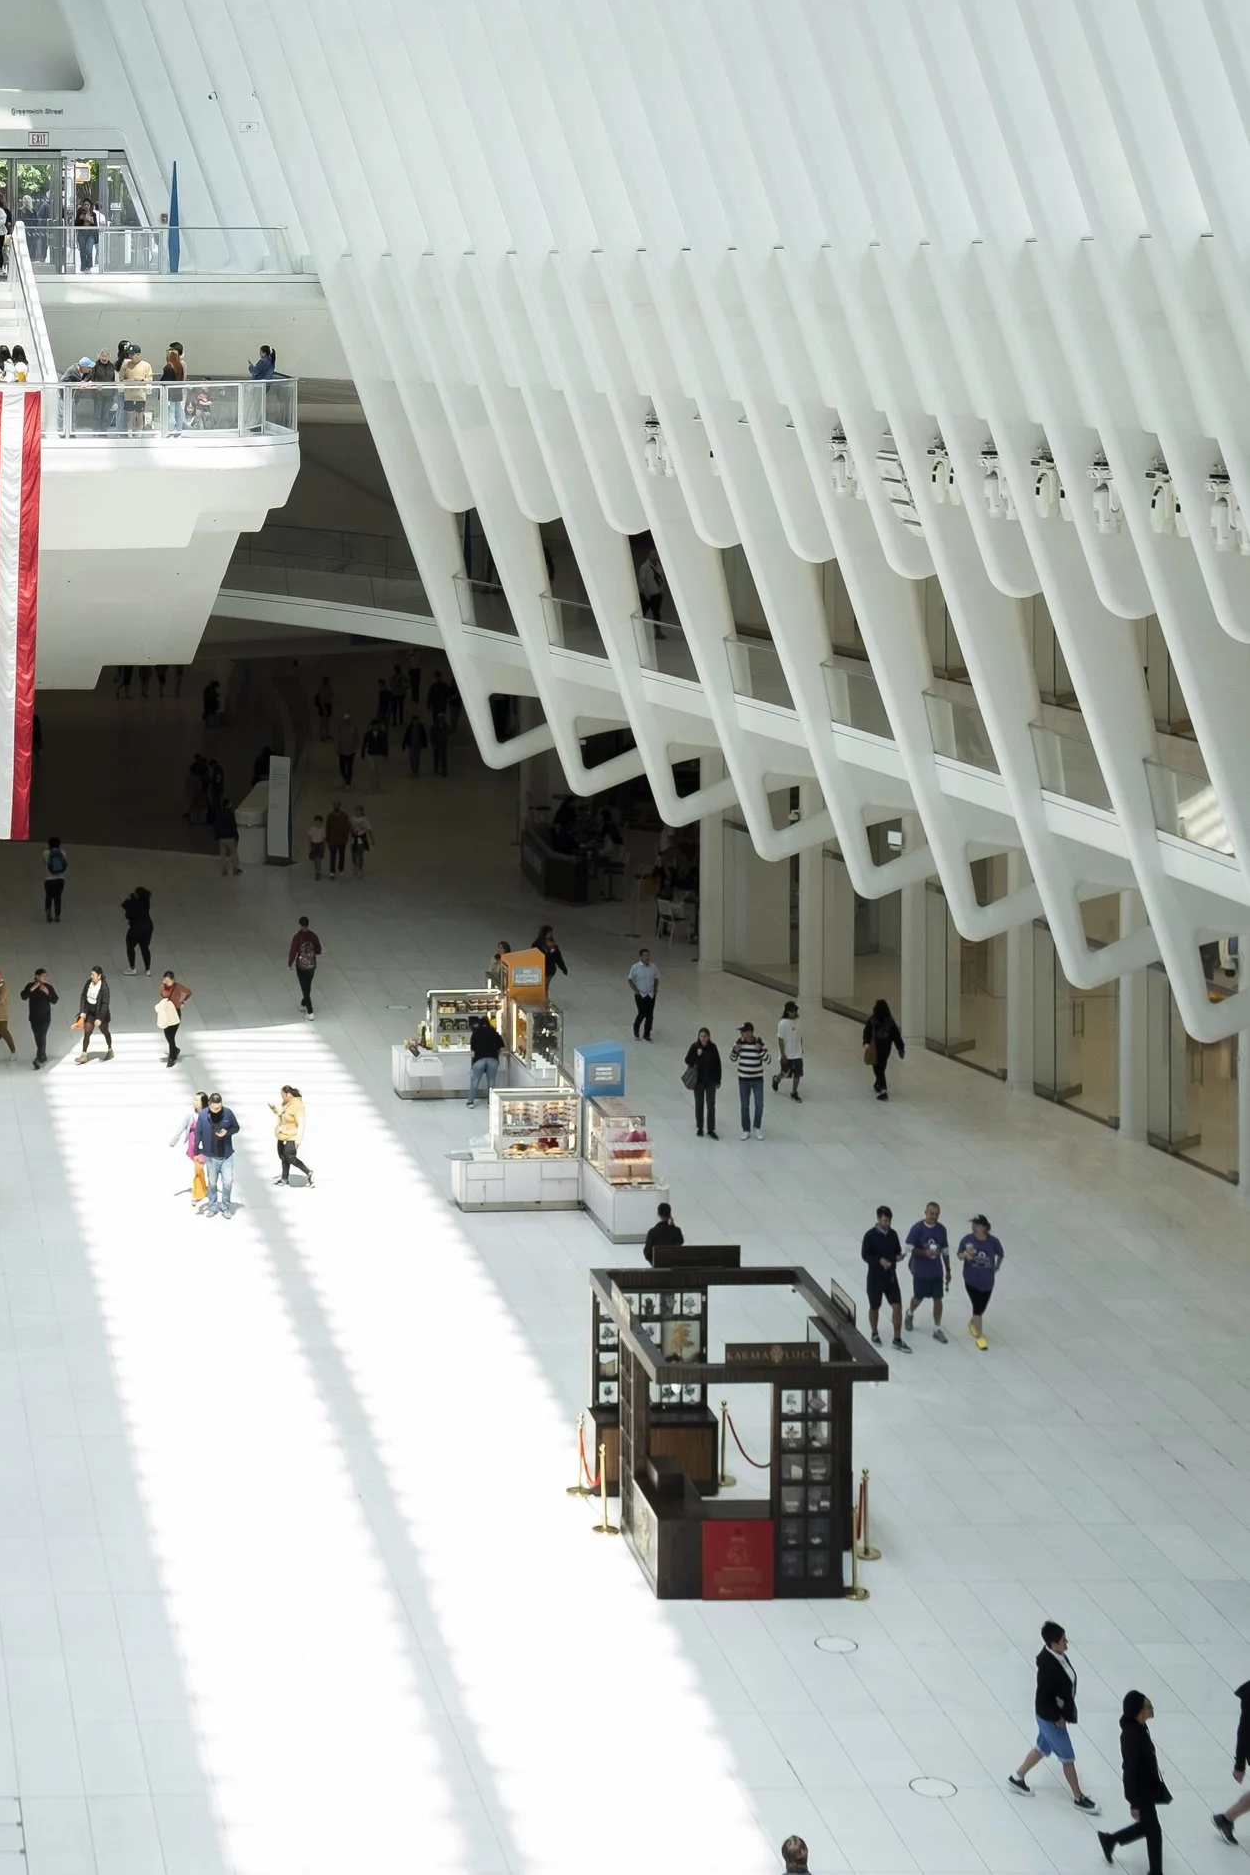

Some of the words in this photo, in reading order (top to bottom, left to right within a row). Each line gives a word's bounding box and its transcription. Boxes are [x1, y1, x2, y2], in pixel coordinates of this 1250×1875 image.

[11, 108, 44, 116] Greenwich
[31, 134, 46, 144] EXIT
[726, 1350, 770, 1361] KARMA
[785, 1350, 819, 1360] LUCK
